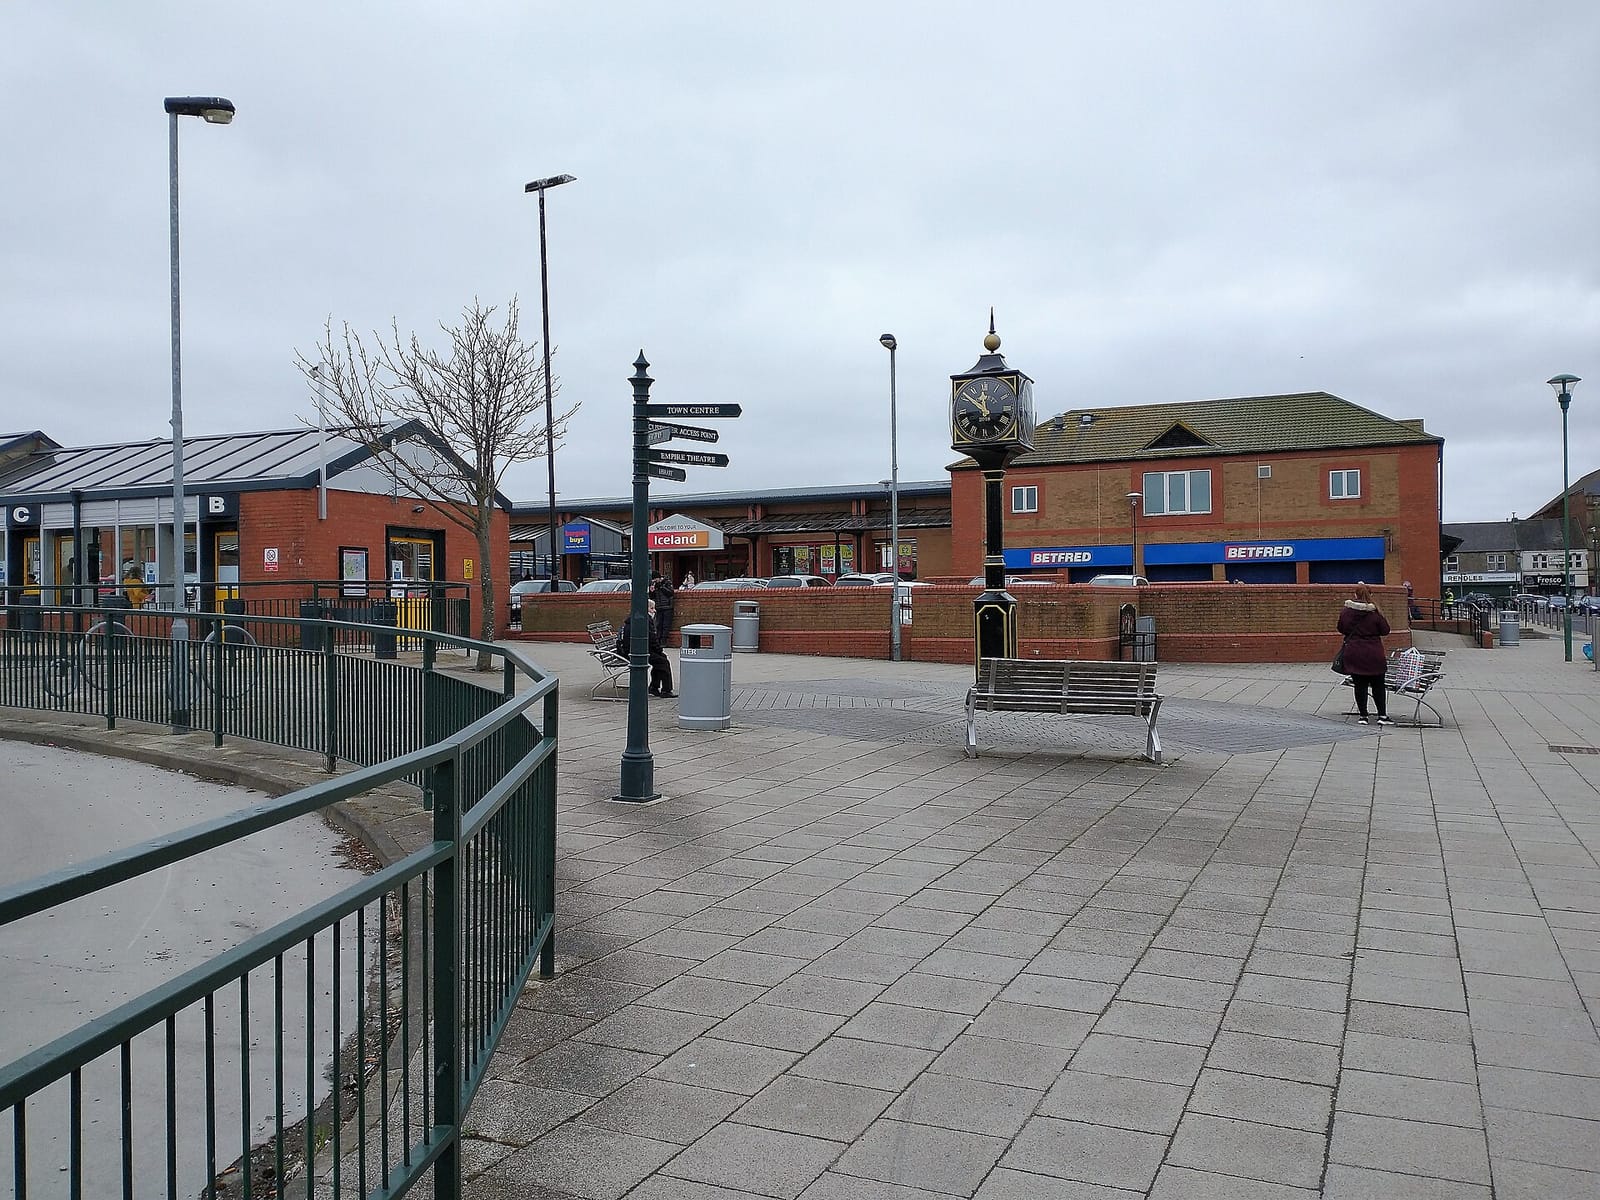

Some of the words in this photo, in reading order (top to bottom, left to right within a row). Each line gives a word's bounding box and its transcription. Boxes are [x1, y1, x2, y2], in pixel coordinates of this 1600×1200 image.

[667, 406, 688, 414] TOWN
[689, 406, 720, 414] CENTRE
[679, 428, 700, 437] ACCESS
[700, 431, 717, 439] POINT
[660, 452, 686, 461] EMPIRE
[686, 454, 716, 463] THEATRE
[208, 496, 225, 513] B
[13, 506, 30, 522] C
[569, 536, 584, 544] buys
[654, 534, 697, 545] Iceland
[1032, 551, 1092, 563] BETFRED
[1228, 546, 1294, 558] BETFRED
[1537, 576, 1562, 584] Fresco
